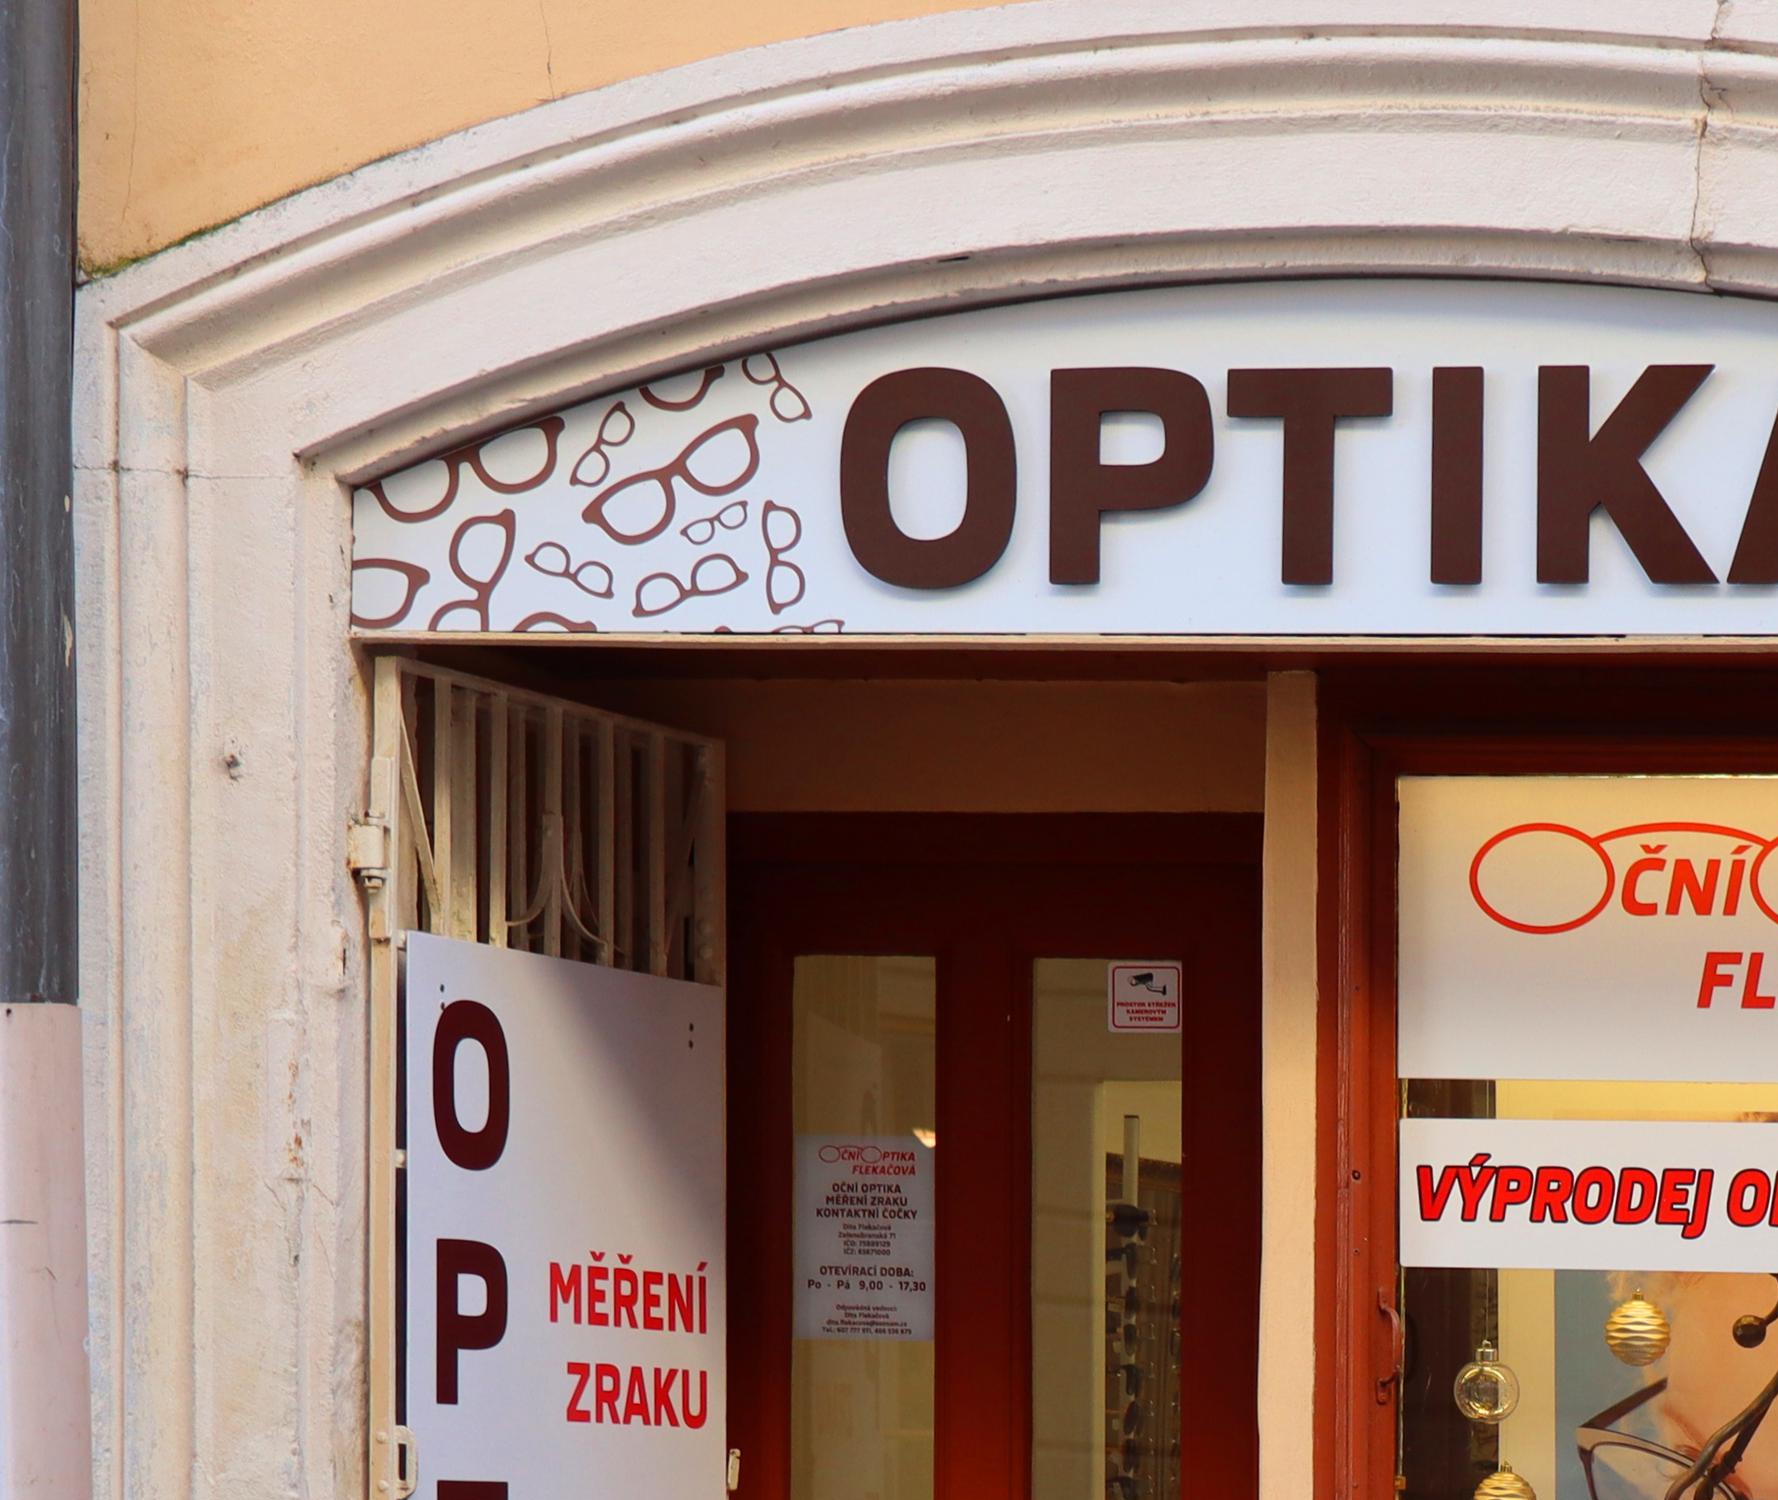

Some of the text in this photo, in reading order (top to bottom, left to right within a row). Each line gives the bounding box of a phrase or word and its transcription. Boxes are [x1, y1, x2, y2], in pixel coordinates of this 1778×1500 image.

[852, 1163, 916, 1176] FLEKAČOVÁ
[832, 1182, 902, 1194] OČNÍ OPTIKA
[825, 1193, 908, 1207] MĚŘENÍ ZRAKU
[1415, 1153, 1711, 1241] VÝPRODEJ
[815, 1206, 918, 1219] KONTAKTNÍ ČOČKY
[820, 1264, 914, 1277] OTEVÍRACÍ DOBA:
[807, 1279, 822, 1289] Po
[836, 1279, 850, 1290] Pá
[858, 1280, 884, 1292] 9,00
[898, 1281, 927, 1292] 17,30
[549, 1252, 707, 1335] MĚŘENÍ
[566, 1360, 708, 1430] ZRAKU
